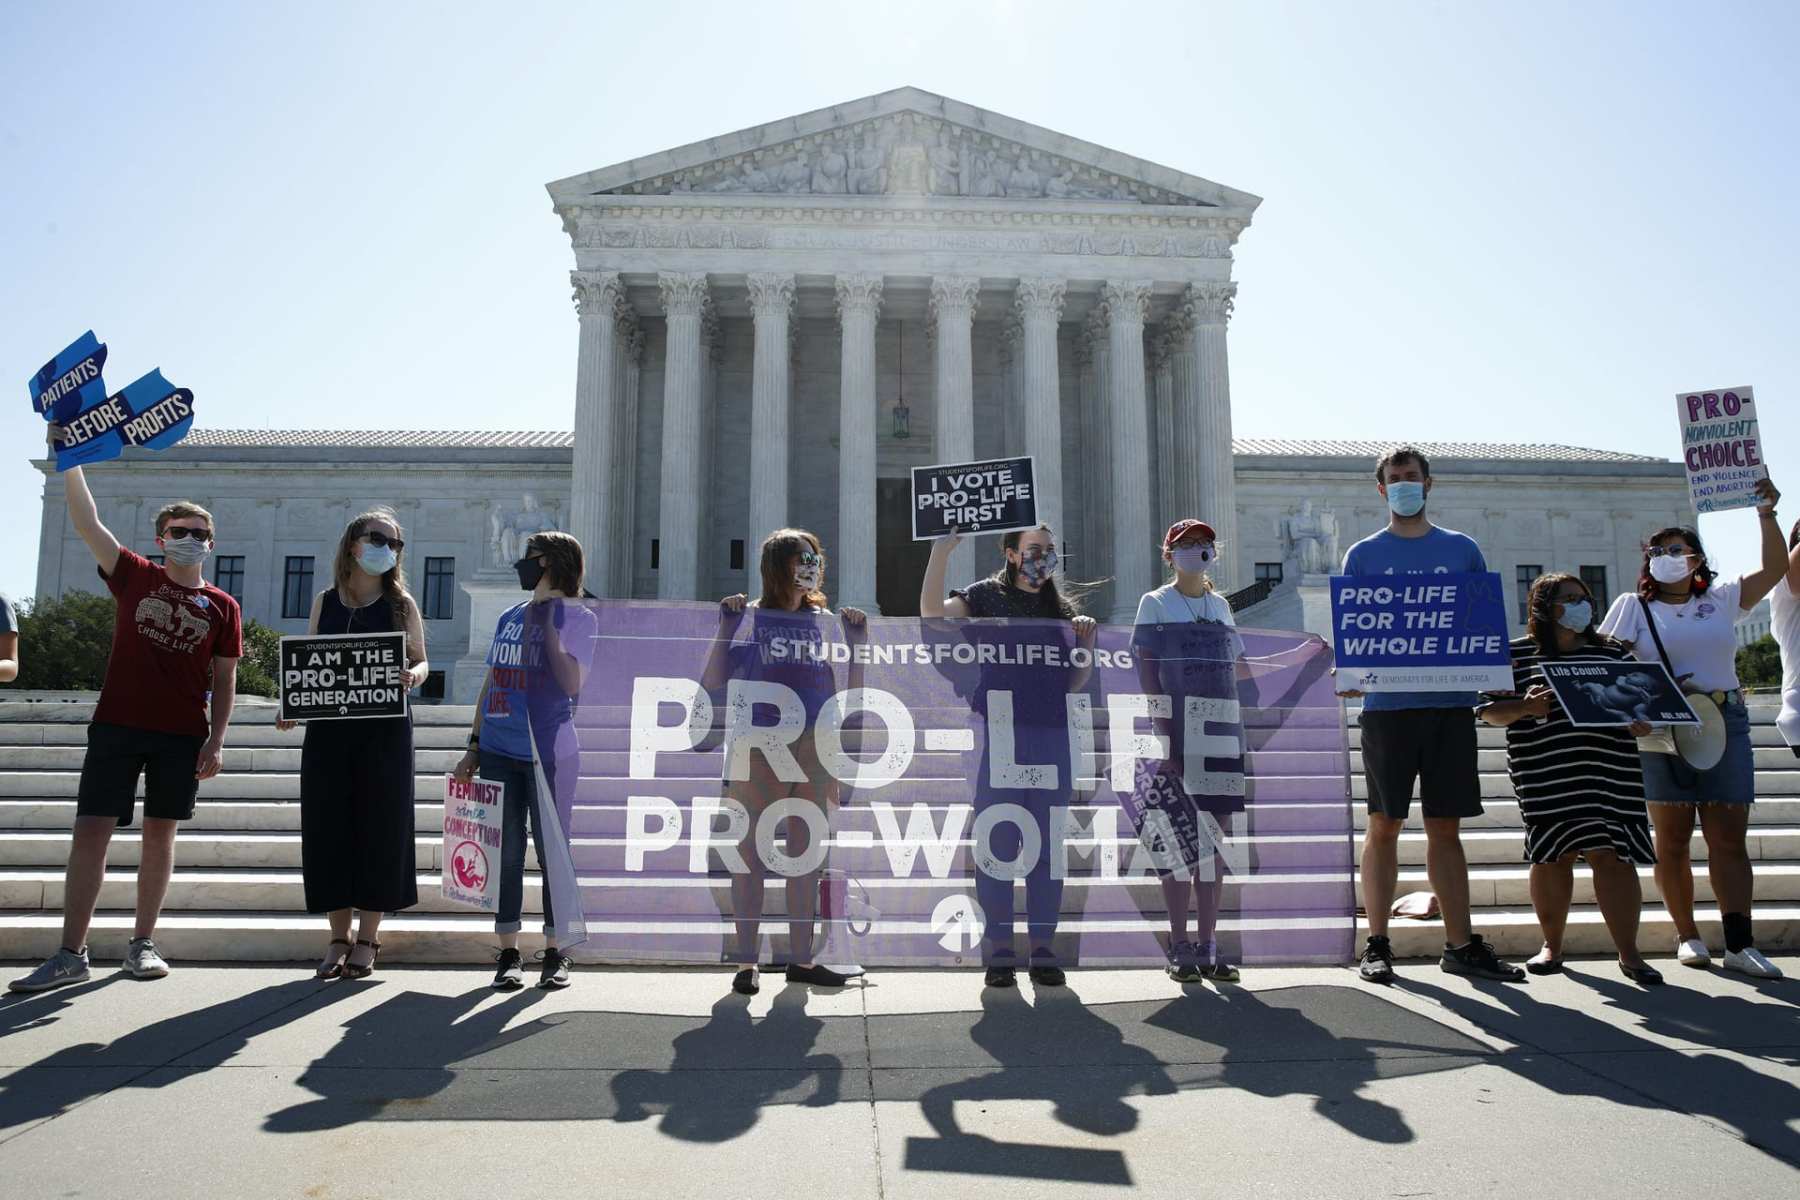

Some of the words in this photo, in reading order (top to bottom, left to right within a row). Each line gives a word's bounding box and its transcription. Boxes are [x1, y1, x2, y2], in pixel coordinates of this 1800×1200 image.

[41, 358, 98, 410] PATIENTS
[123, 394, 190, 446] PROFITS
[1686, 392, 1751, 422] PRO-
[64, 398, 128, 447] BEFORE
[1685, 419, 1758, 443] NONVIOLENT
[1686, 440, 1760, 472] CHOICE
[931, 478, 938, 491] I
[947, 470, 1013, 490] VOTE
[1692, 475, 1709, 484] END
[1693, 486, 1713, 497] END
[918, 483, 1030, 510] PRO-LIFE
[944, 503, 1005, 525] FIRST
[1339, 586, 1457, 605] PRO-LIFE
[1341, 612, 1395, 630] FOR
[1404, 611, 1454, 629] THE
[138, 625, 169, 644] CHOOSE
[172, 640, 194, 653] LIFE
[1344, 637, 1438, 655] WHOLE
[1447, 636, 1501, 654] LIFE
[291, 653, 297, 667] I
[308, 652, 341, 666] AM
[352, 649, 394, 664] THE
[770, 636, 1133, 670] STUDENTSFORLIFE.ORG
[285, 666, 401, 688] PRO-LIFE
[288, 688, 399, 706] GENERATION
[629, 677, 1246, 795] PRO-LIFE
[449, 778, 501, 806] FEMINIST
[444, 815, 500, 849] CONCEPTION
[625, 796, 1250, 883] PRO-WOMAN
